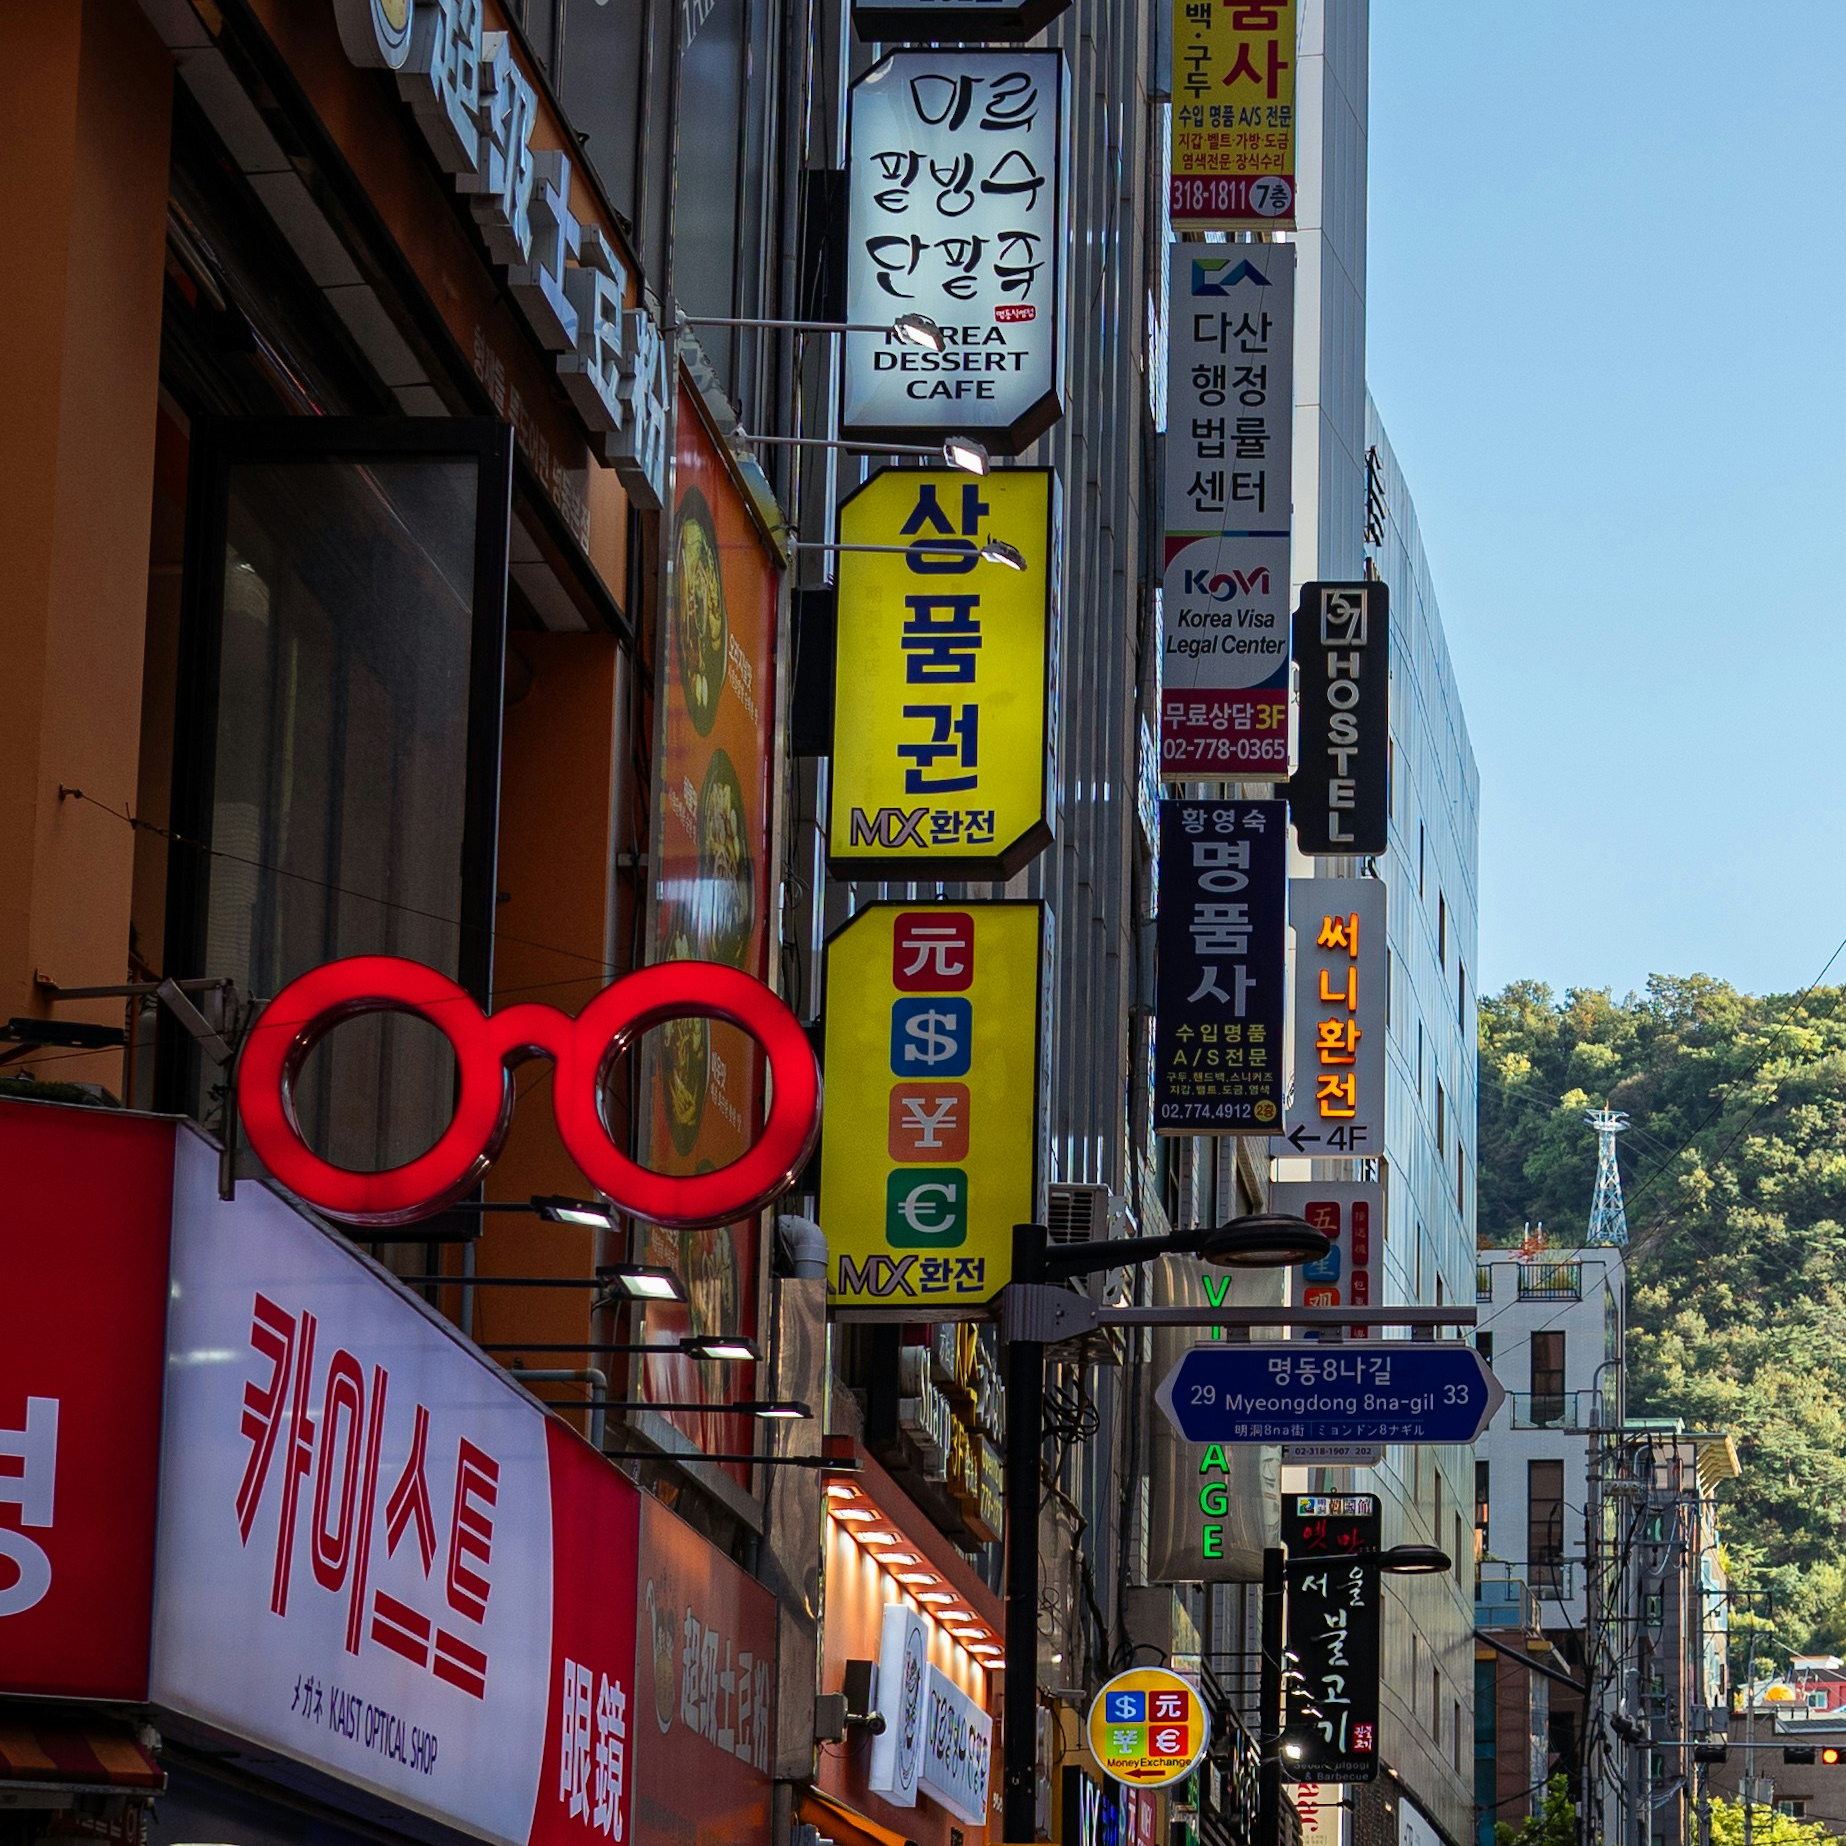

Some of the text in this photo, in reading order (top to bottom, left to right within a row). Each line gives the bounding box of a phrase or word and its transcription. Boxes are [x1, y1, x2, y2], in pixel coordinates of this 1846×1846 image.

[1178, 104, 1292, 127] 수입 명품 A/S 전문
[871, 149, 1045, 217] 팥빙수
[1173, 180, 1289, 210] 318-1811 7층
[1193, 311, 1272, 353] 다산
[874, 352, 1028, 374] DESSERT
[907, 380, 995, 400] CAFE
[1192, 365, 1268, 406] 행정
[1192, 417, 1270, 459] 법률
[1187, 470, 1266, 513] 센터
[1178, 609, 1275, 629] Korea Visa
[897, 483, 989, 795] 상품권
[1166, 634, 1285, 657] Legal Center
[1164, 703, 1285, 731] 무료상담 3F
[1163, 738, 1285, 761] 02-778-0365
[1327, 652, 1360, 842] HOSTEL
[850, 806, 996, 848] MX 환전
[1181, 809, 1267, 834] 황영숙
[1187, 840, 1257, 1017] 명품사
[902, 926, 966, 977] 元
[1316, 913, 1361, 1118] 써니환전
[1175, 1023, 1267, 1043] 수입명품
[1162, 1102, 1275, 1120] 02.774.4912 2층
[1326, 1126, 1367, 1151] 4F
[838, 1253, 986, 1298] MX 환전
[1267, 1357, 1392, 1384] 명동8나길
[1190, 1385, 1216, 1405] 29
[1225, 1393, 1435, 1414] Myeongdong 8na-gil
[1443, 1384, 1469, 1405] 33
[1234, 1423, 1425, 1438] 明洞8na街 ミョンドン8ナギル
[1354, 1447, 1373, 1456] 202
[235, 1291, 501, 1700] 카이스트
[292, 1672, 438, 1776] メガネ KAIST OPTICAL SHOP
[559, 1656, 626, 1845] 眼鏡
[1107, 1758, 1192, 1768] Money Exchange
[1317, 1771, 1370, 1782] Barbecue
